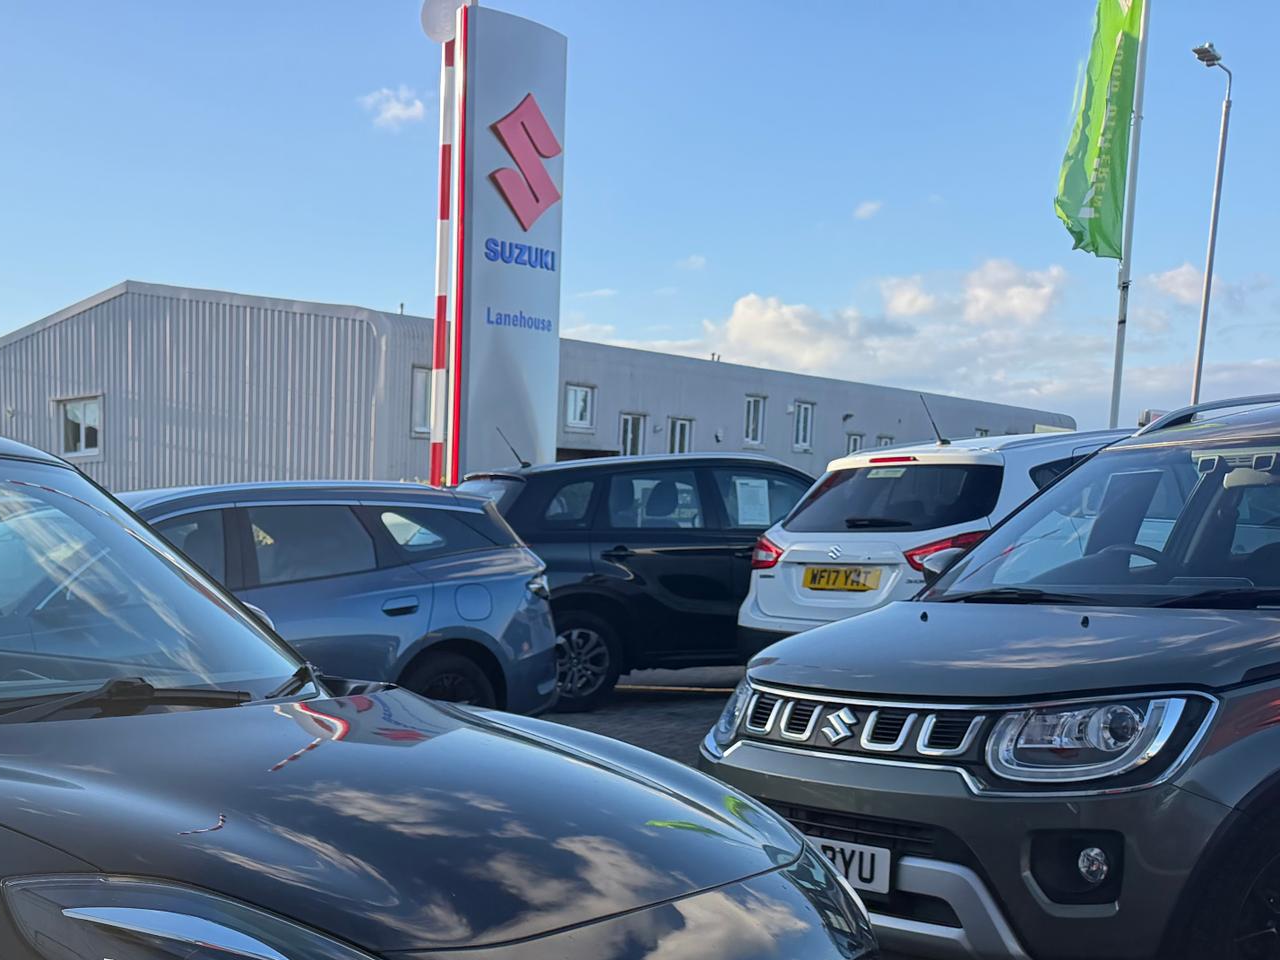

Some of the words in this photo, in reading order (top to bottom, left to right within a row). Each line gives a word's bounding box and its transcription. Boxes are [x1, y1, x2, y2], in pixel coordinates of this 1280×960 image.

[484, 238, 556, 272] SUZUKI
[486, 306, 553, 332] Lanehouse
[810, 569, 840, 586] WF17
